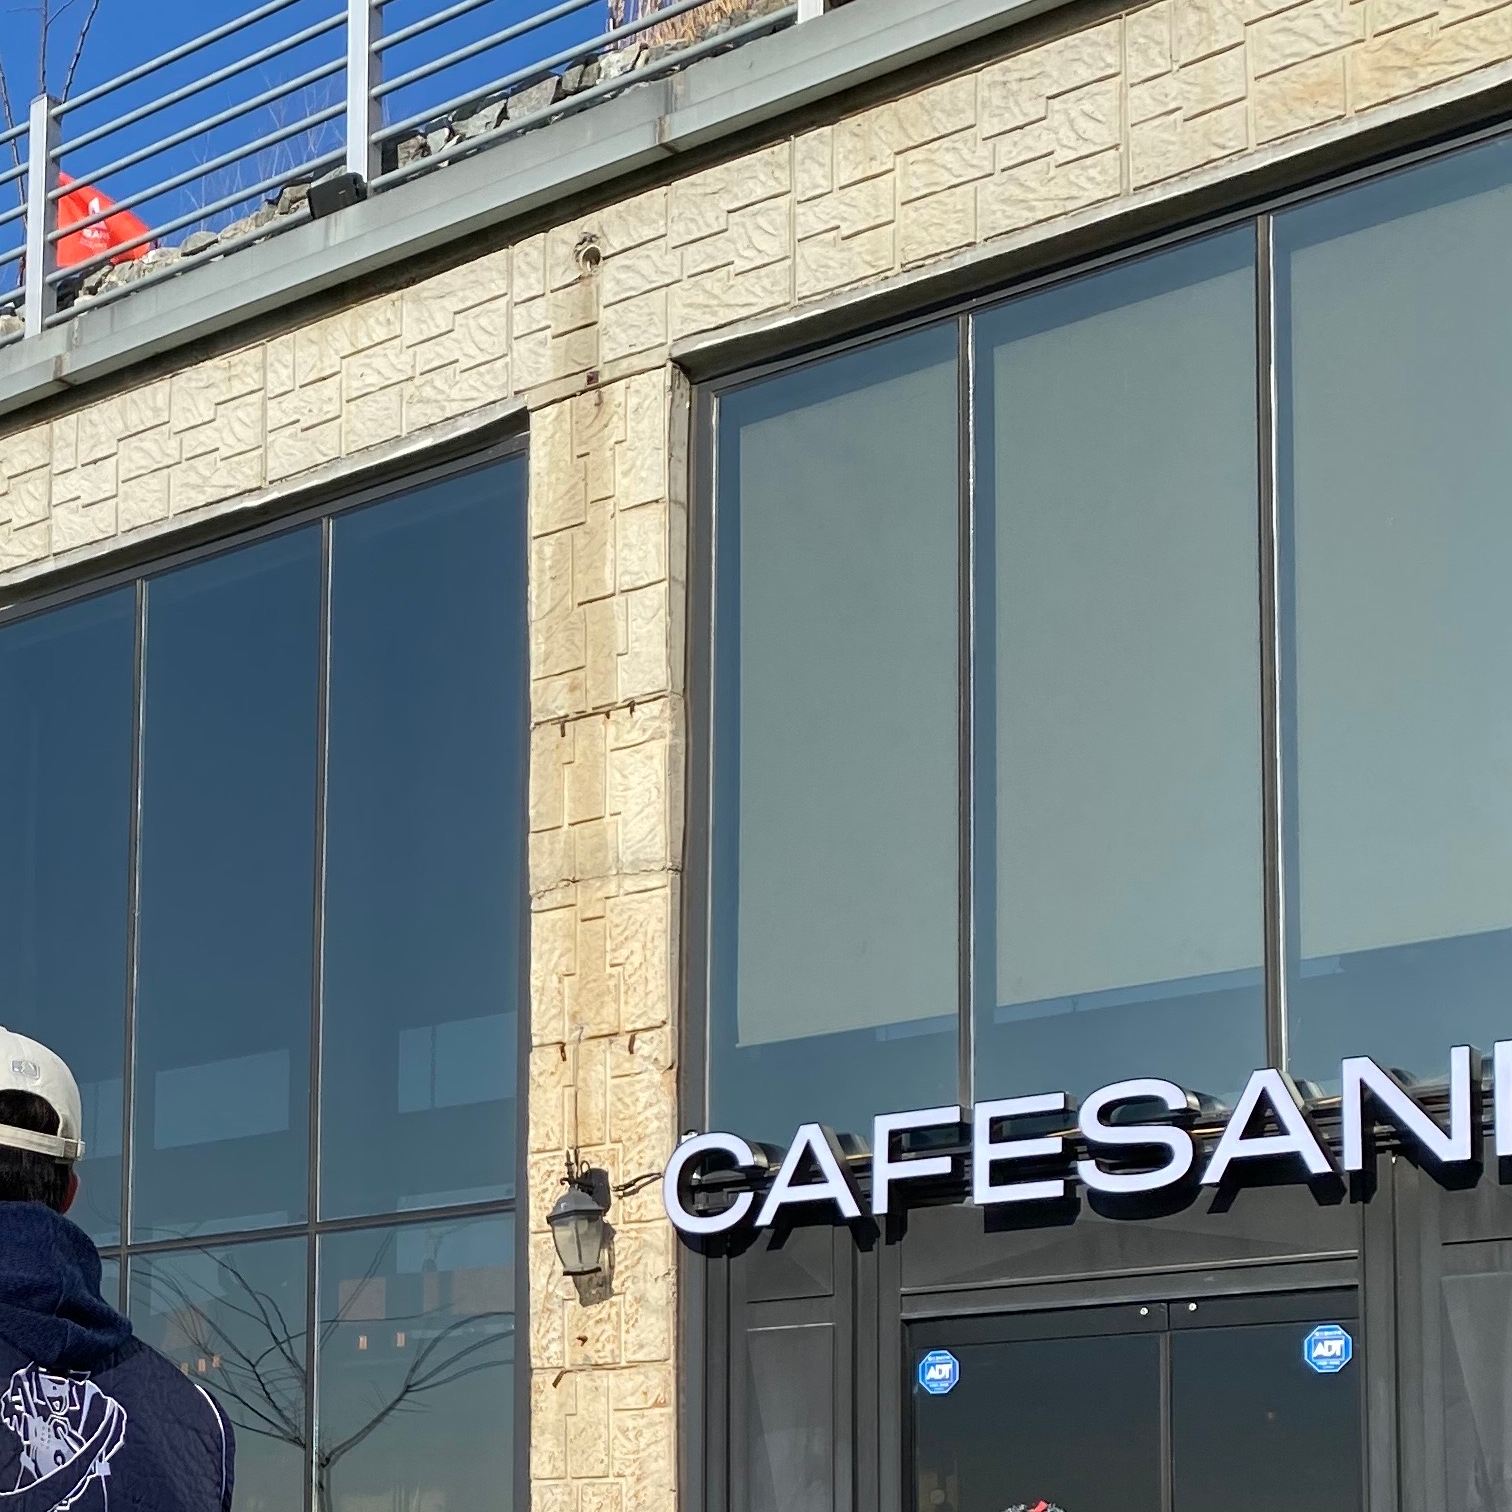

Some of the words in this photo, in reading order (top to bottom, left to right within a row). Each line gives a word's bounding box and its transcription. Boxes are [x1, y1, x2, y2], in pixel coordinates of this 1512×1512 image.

[663, 1040, 1512, 1236] CAFESAN
[1313, 1340, 1345, 1358] ADT
[926, 1363, 953, 1380] ADT
